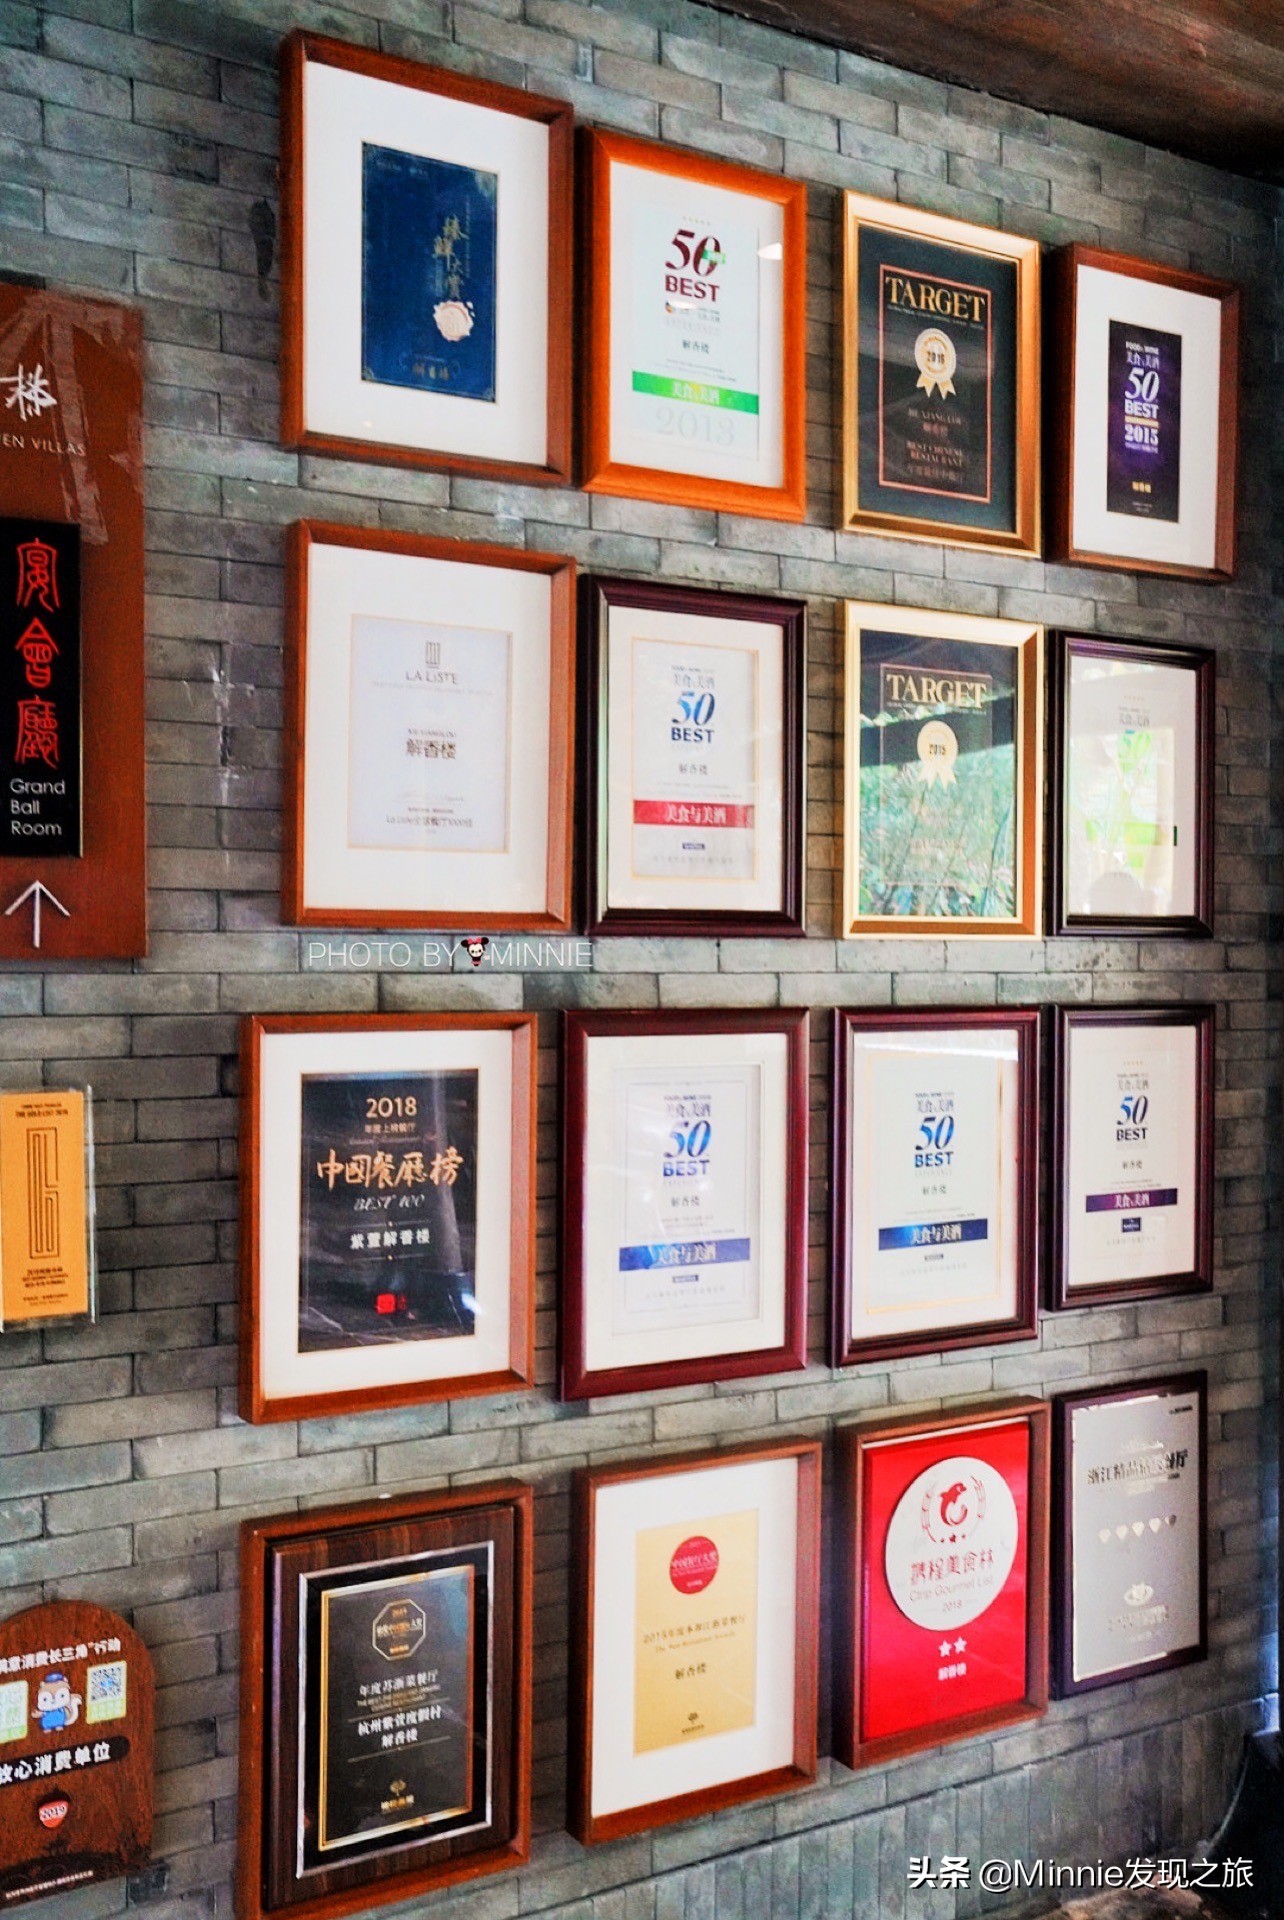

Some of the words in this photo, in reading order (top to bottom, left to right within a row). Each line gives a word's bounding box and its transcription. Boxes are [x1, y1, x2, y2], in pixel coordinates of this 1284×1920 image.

[665, 228, 721, 277] 50
[665, 273, 720, 302] BEST
[885, 275, 986, 322] TARGET
[1125, 367, 1160, 402] 50
[1125, 399, 1159, 419] BEST
[1125, 425, 1159, 445] 2015
[31, 438, 86, 456] VILLAS
[886, 674, 987, 709] TARGET
[671, 690, 716, 726] 50
[671, 727, 716, 744] BEST
[10, 778, 65, 795] Grand
[11, 800, 40, 815] Ball
[11, 821, 62, 836] Room
[366, 1096, 418, 1119] 2018
[1117, 1095, 1149, 1126] 50
[664, 1120, 711, 1158] 50
[915, 1115, 954, 1151] 50
[1117, 1128, 1148, 1142] BEST
[663, 1160, 710, 1177] BEST
[914, 1151, 954, 1168] BEST
